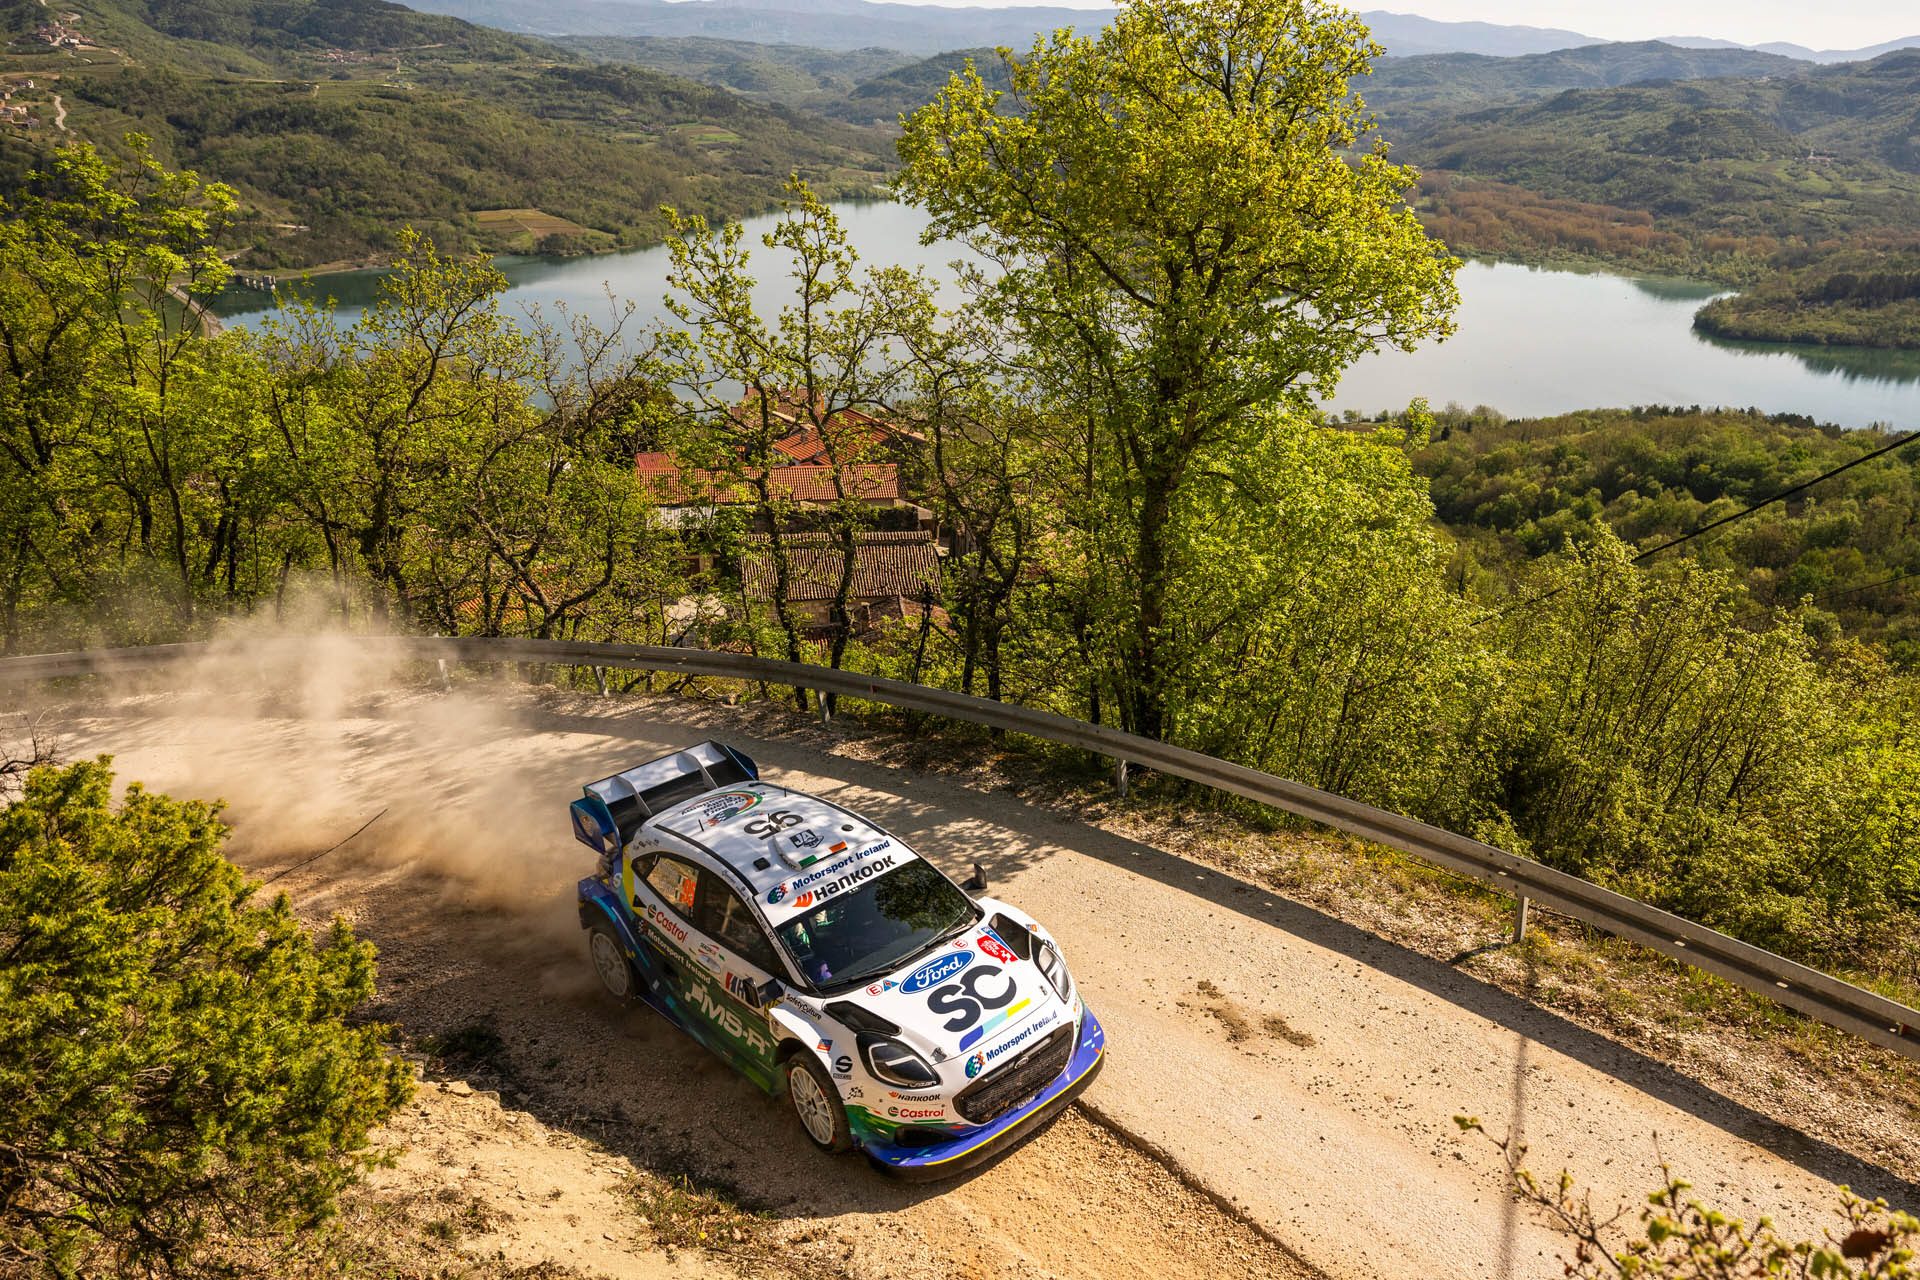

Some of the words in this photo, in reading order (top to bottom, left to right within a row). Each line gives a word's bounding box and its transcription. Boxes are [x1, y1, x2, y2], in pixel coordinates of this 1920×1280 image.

[792, 855, 854, 890] Motorsport
[855, 840, 890, 859] Ireland
[656, 911, 688, 943] Castrol
[647, 929, 685, 963] Motorsport
[685, 959, 711, 984] Ireland
[915, 956, 963, 988] Ford
[786, 993, 822, 1020] SafetyCulture
[927, 965, 1017, 1032] SC
[986, 1027, 1032, 1061] Motorsport
[900, 1109, 945, 1118] Castrol
